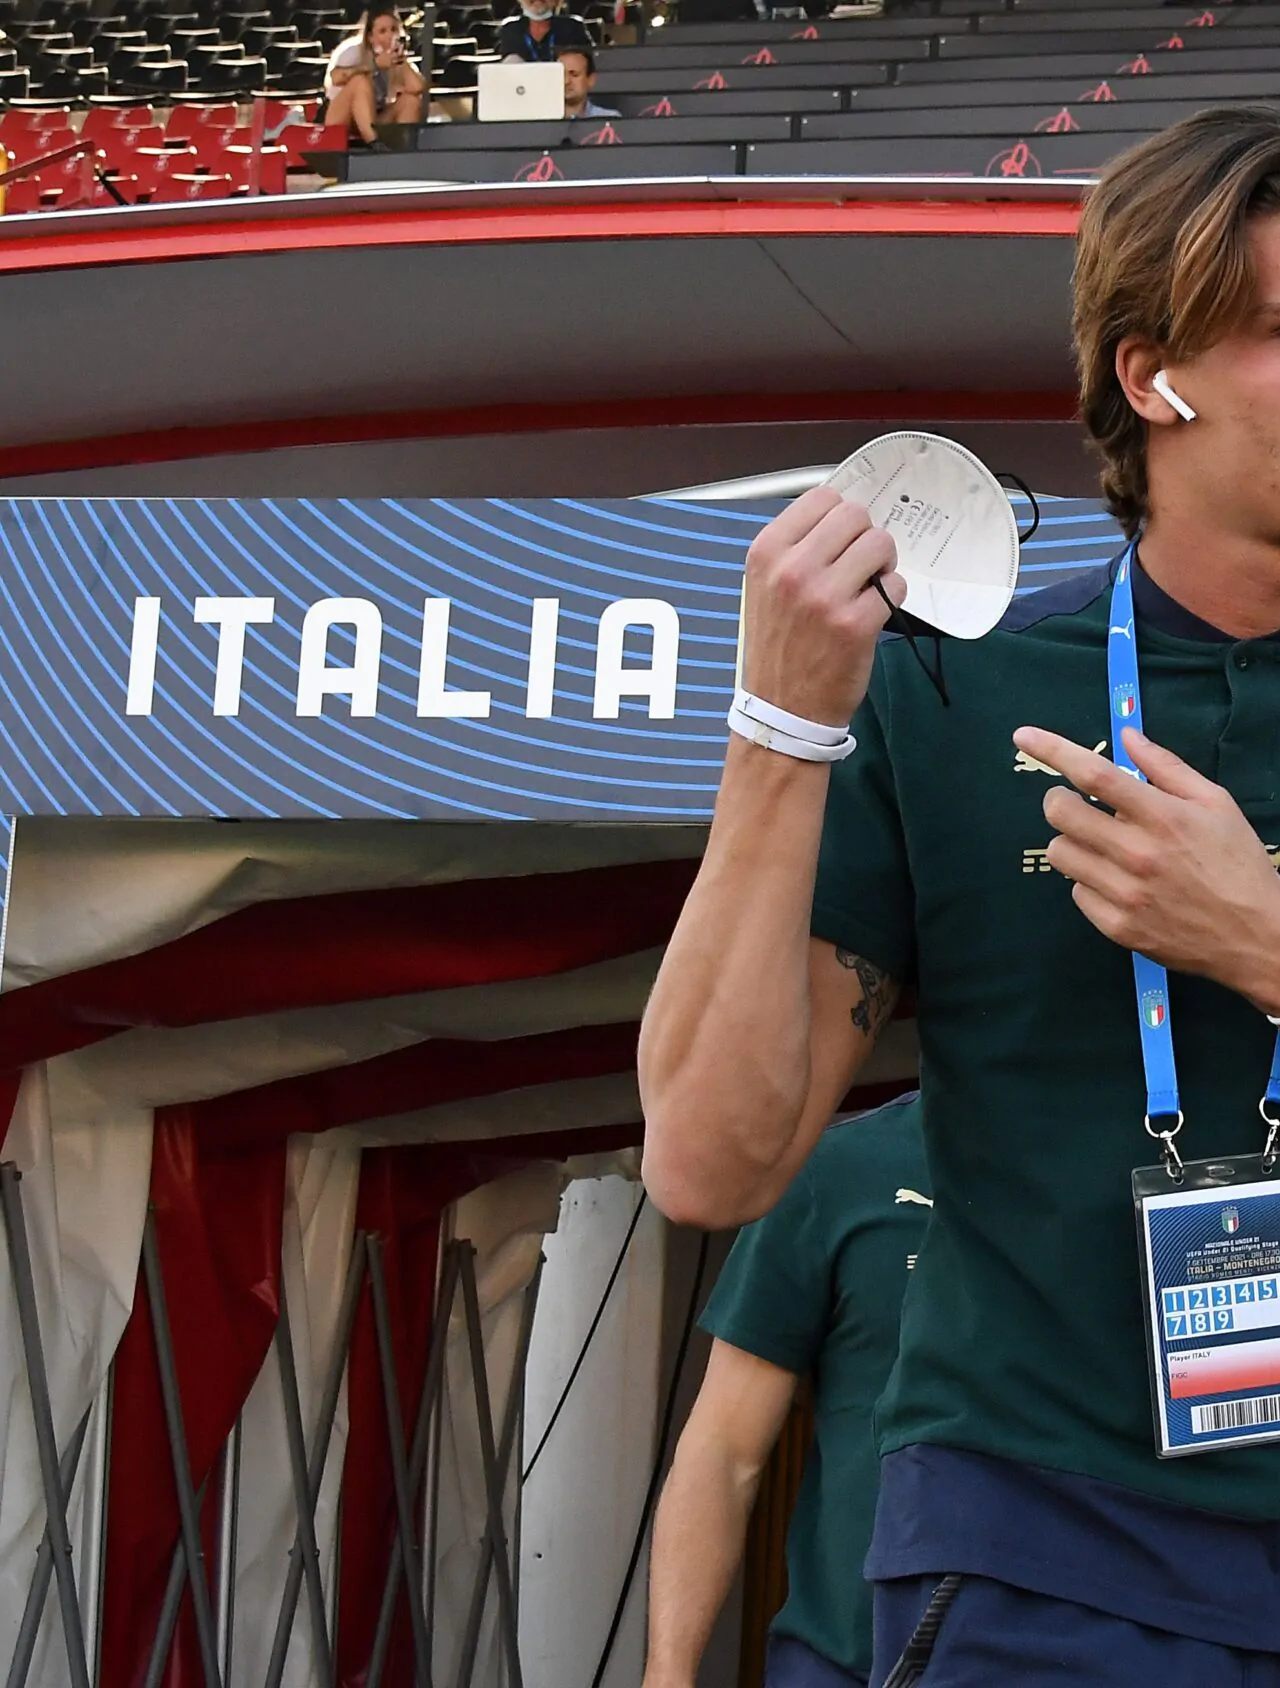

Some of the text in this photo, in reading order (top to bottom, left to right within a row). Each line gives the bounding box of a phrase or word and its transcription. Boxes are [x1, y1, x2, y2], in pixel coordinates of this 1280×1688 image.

[126, 596, 680, 719] ITALIA
[1187, 1265, 1214, 1276] ITALIA
[1172, 1293, 1178, 1311] 1
[1194, 1290, 1205, 1308] 2
[1216, 1287, 1227, 1305] 3
[1238, 1284, 1251, 1302] 4
[1262, 1281, 1273, 1299] 5
[1170, 1311, 1229, 1335] 7 8 9
[1192, 1351, 1211, 1360] ITALY
